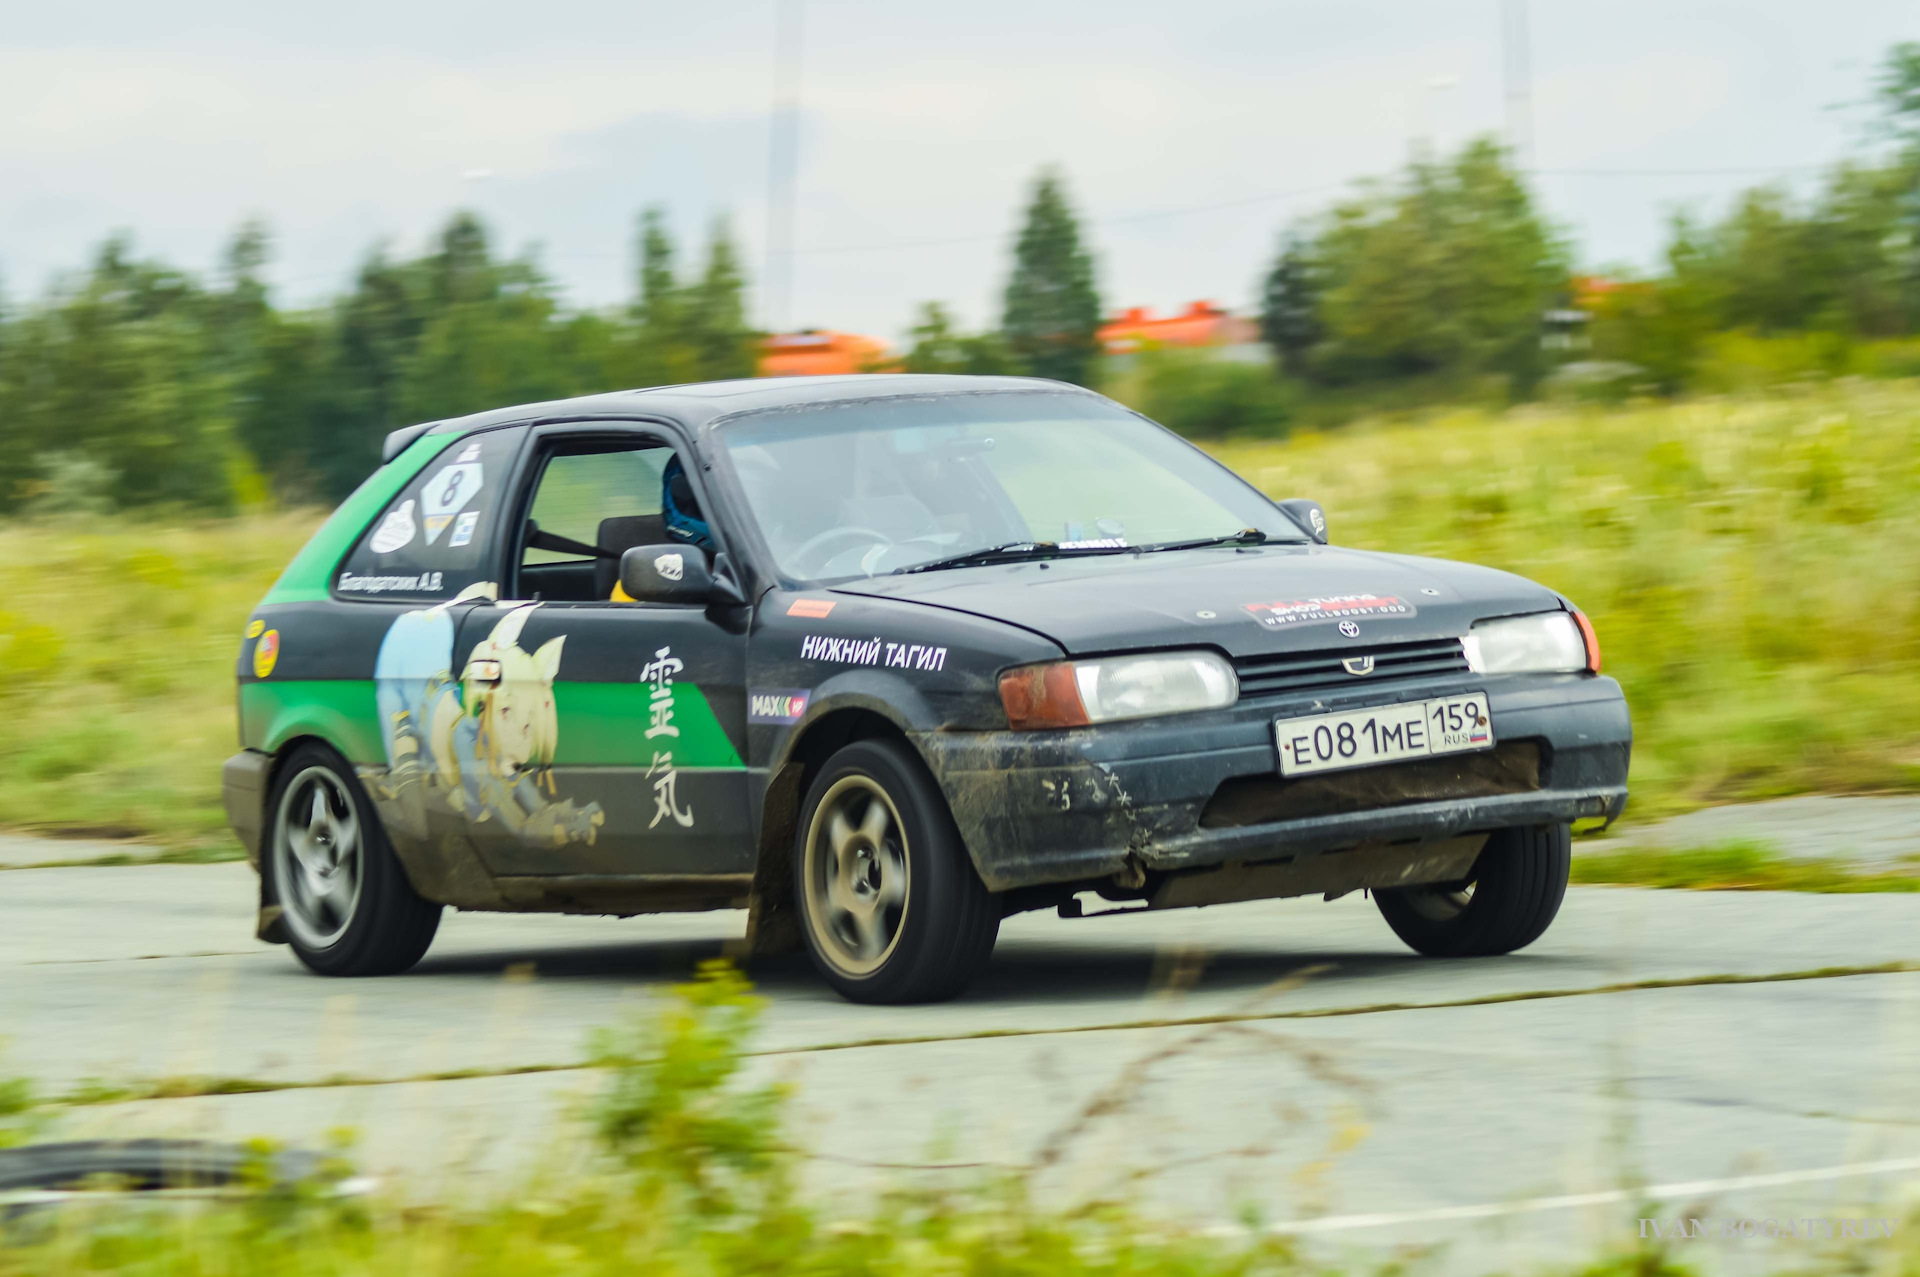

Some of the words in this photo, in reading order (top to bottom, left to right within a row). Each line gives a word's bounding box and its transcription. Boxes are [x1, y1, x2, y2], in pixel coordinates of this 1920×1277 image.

[441, 470, 464, 507] 8
[801, 635, 881, 666] НИЖНИЙ
[885, 642, 947, 671] ТАГИЛ
[1432, 702, 1480, 733] 159
[1443, 732, 1469, 746] RUS
